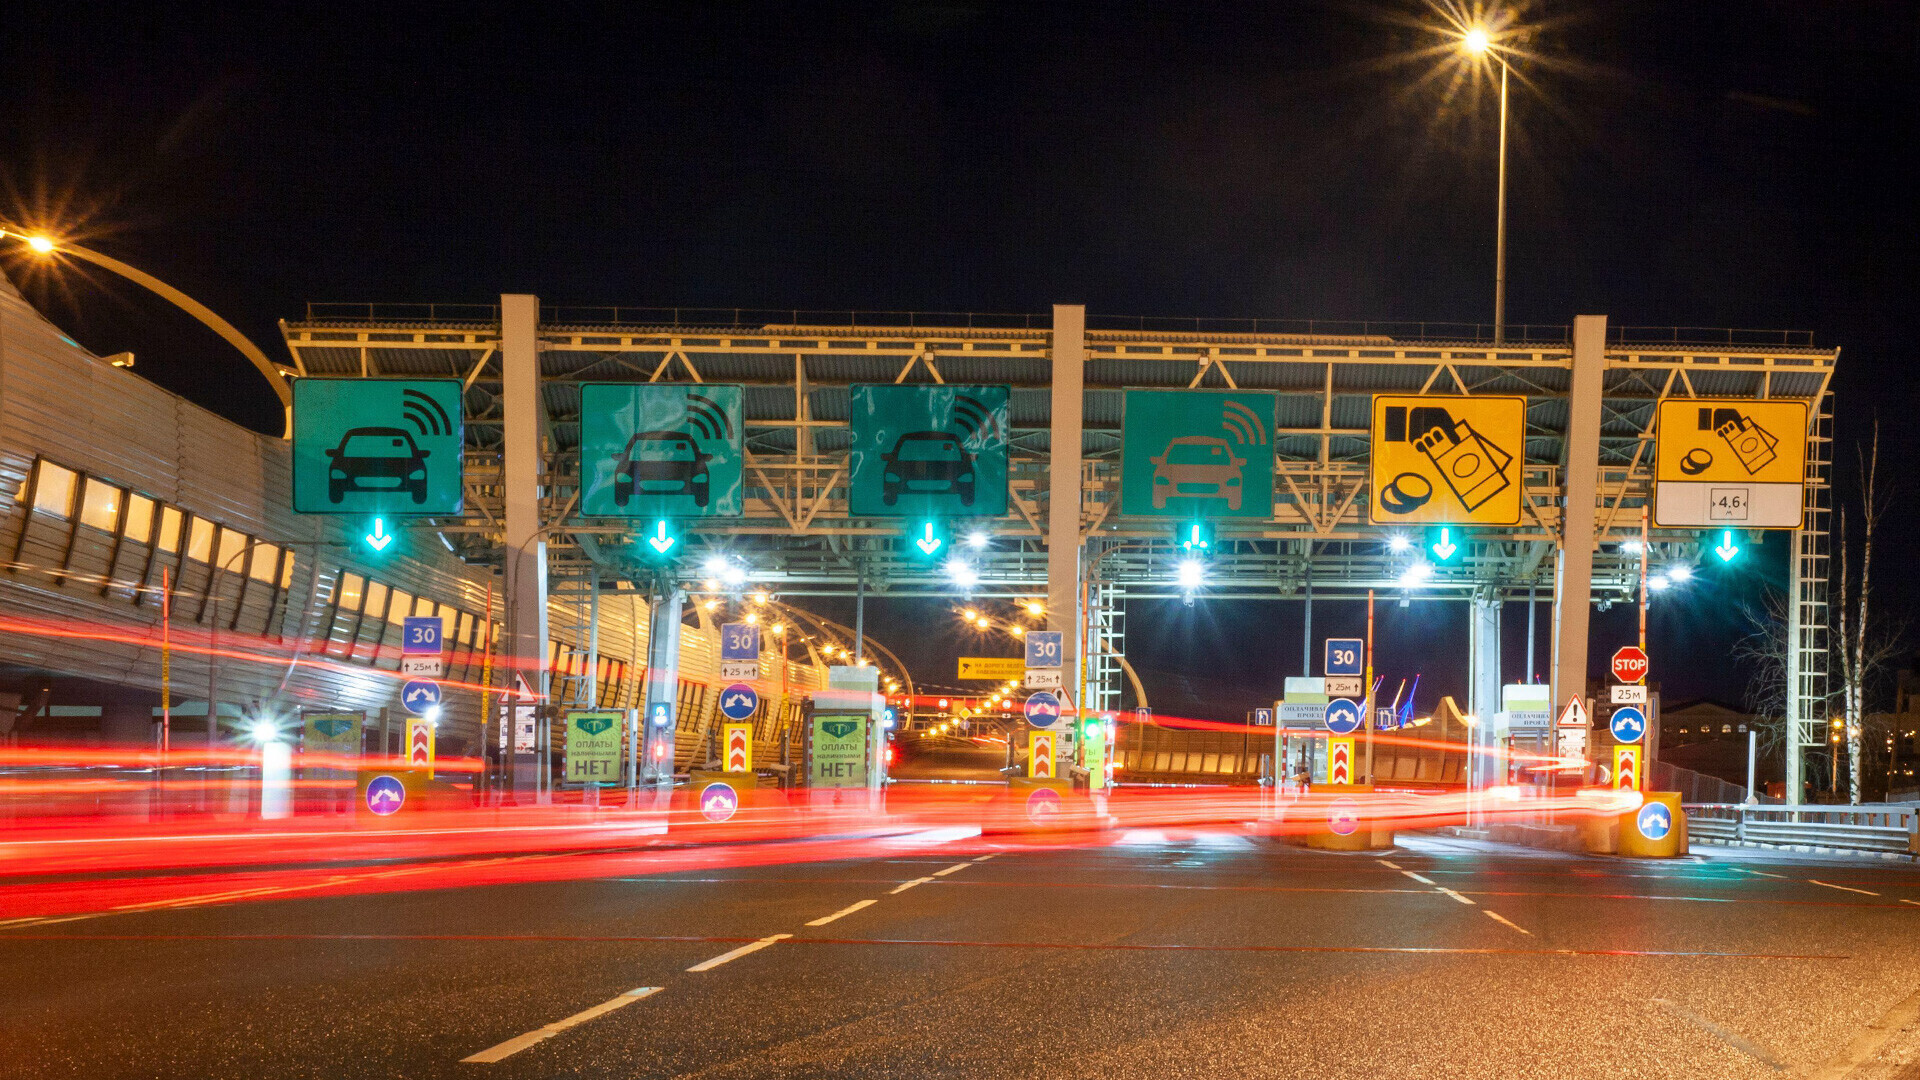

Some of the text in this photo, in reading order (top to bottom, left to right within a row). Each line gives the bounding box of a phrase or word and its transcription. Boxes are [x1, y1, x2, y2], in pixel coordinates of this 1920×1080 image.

[1719, 496, 1740, 508] 4.6
[413, 627, 435, 643] 30
[730, 634, 752, 650] 30
[1034, 642, 1056, 657] 30
[1333, 650, 1354, 665] 30
[413, 663, 431, 671] 25м
[1615, 659, 1646, 671] STOP
[1335, 683, 1351, 691] 25м
[1618, 689, 1641, 700] 25м
[821, 743, 857, 751] ОПЛАТЫ
[575, 760, 611, 775] НЕТ
[820, 762, 856, 777] НЕТ
